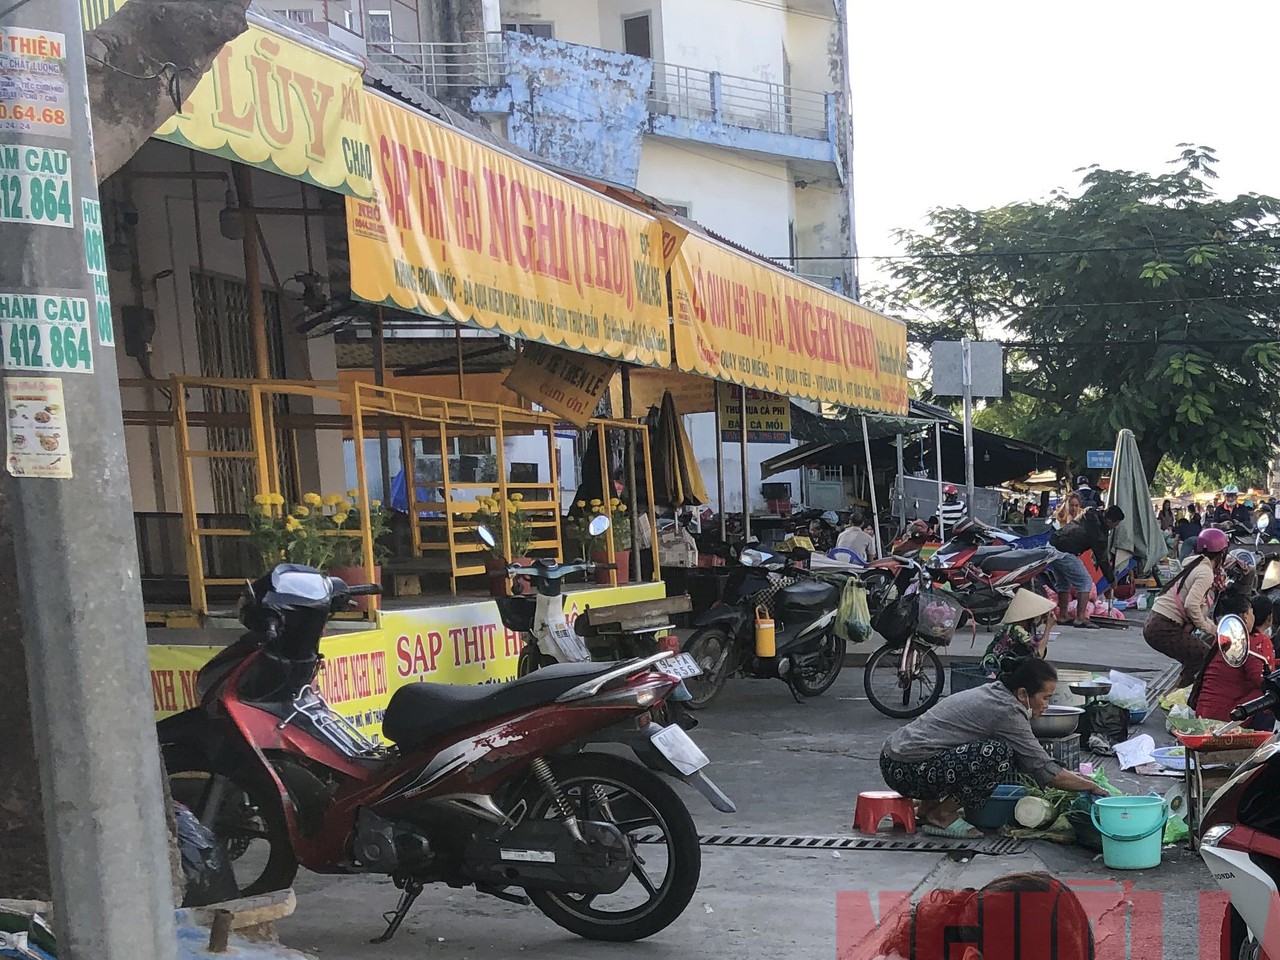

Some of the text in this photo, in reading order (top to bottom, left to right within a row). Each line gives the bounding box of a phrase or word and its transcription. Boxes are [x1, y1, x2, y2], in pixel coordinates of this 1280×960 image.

[483, 166, 571, 285] NGHI
[571, 204, 634, 312] (THU)
[707, 271, 732, 330] QUAY
[785, 294, 842, 366] NGHI
[840, 314, 880, 381] (THU)
[350, 653, 372, 700] NGHI
[371, 651, 387, 696] THU
[396, 630, 443, 682] SẠP
[449, 623, 497, 670] THỊT
